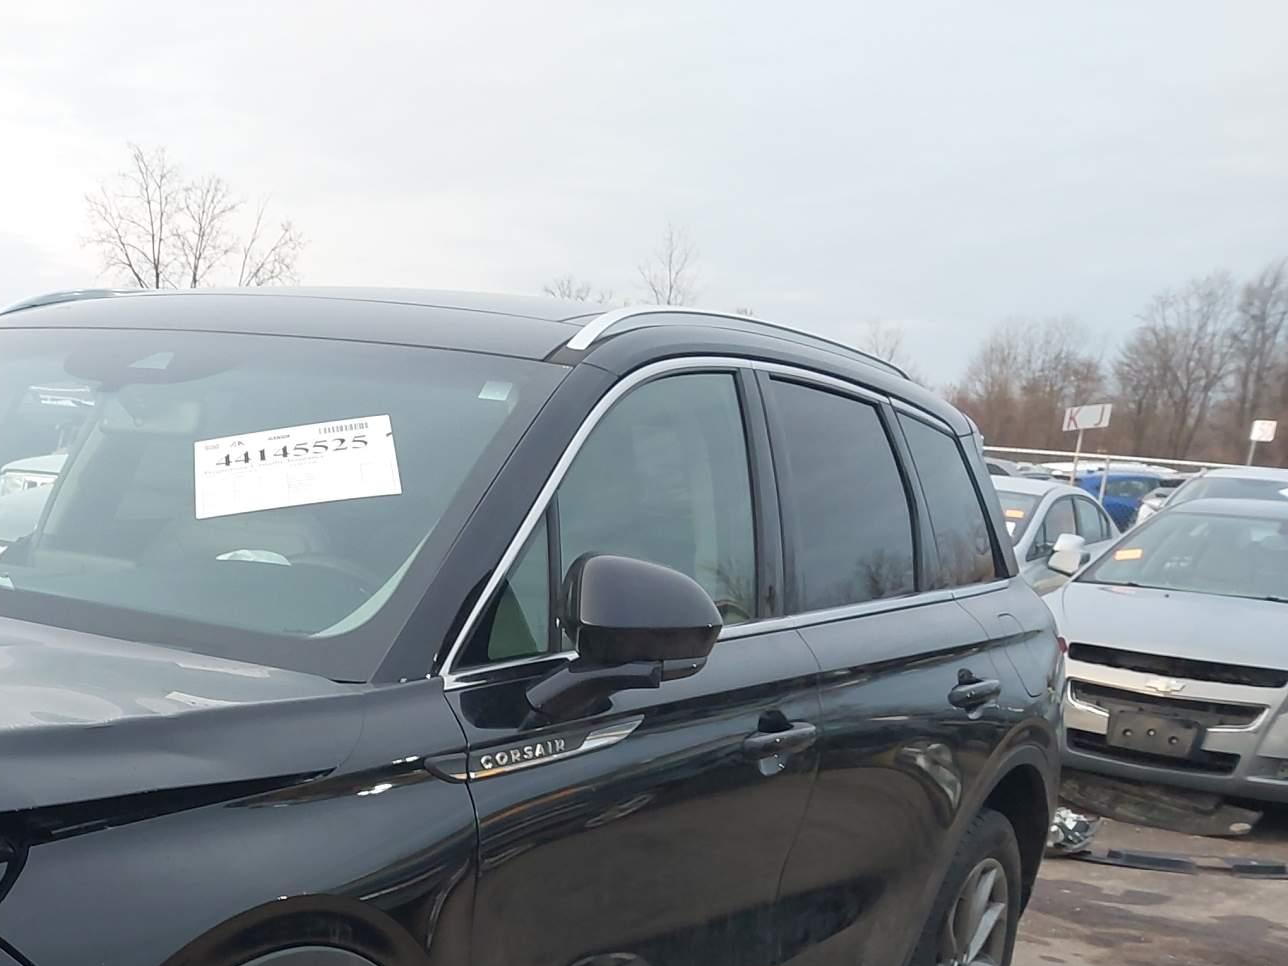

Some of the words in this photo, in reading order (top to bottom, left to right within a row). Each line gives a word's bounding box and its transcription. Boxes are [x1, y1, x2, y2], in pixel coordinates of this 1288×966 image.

[1067, 408, 1080, 429] K
[1093, 405, 1105, 426] J
[215, 434, 369, 467] 44145525
[480, 739, 565, 769] CORSAIR
